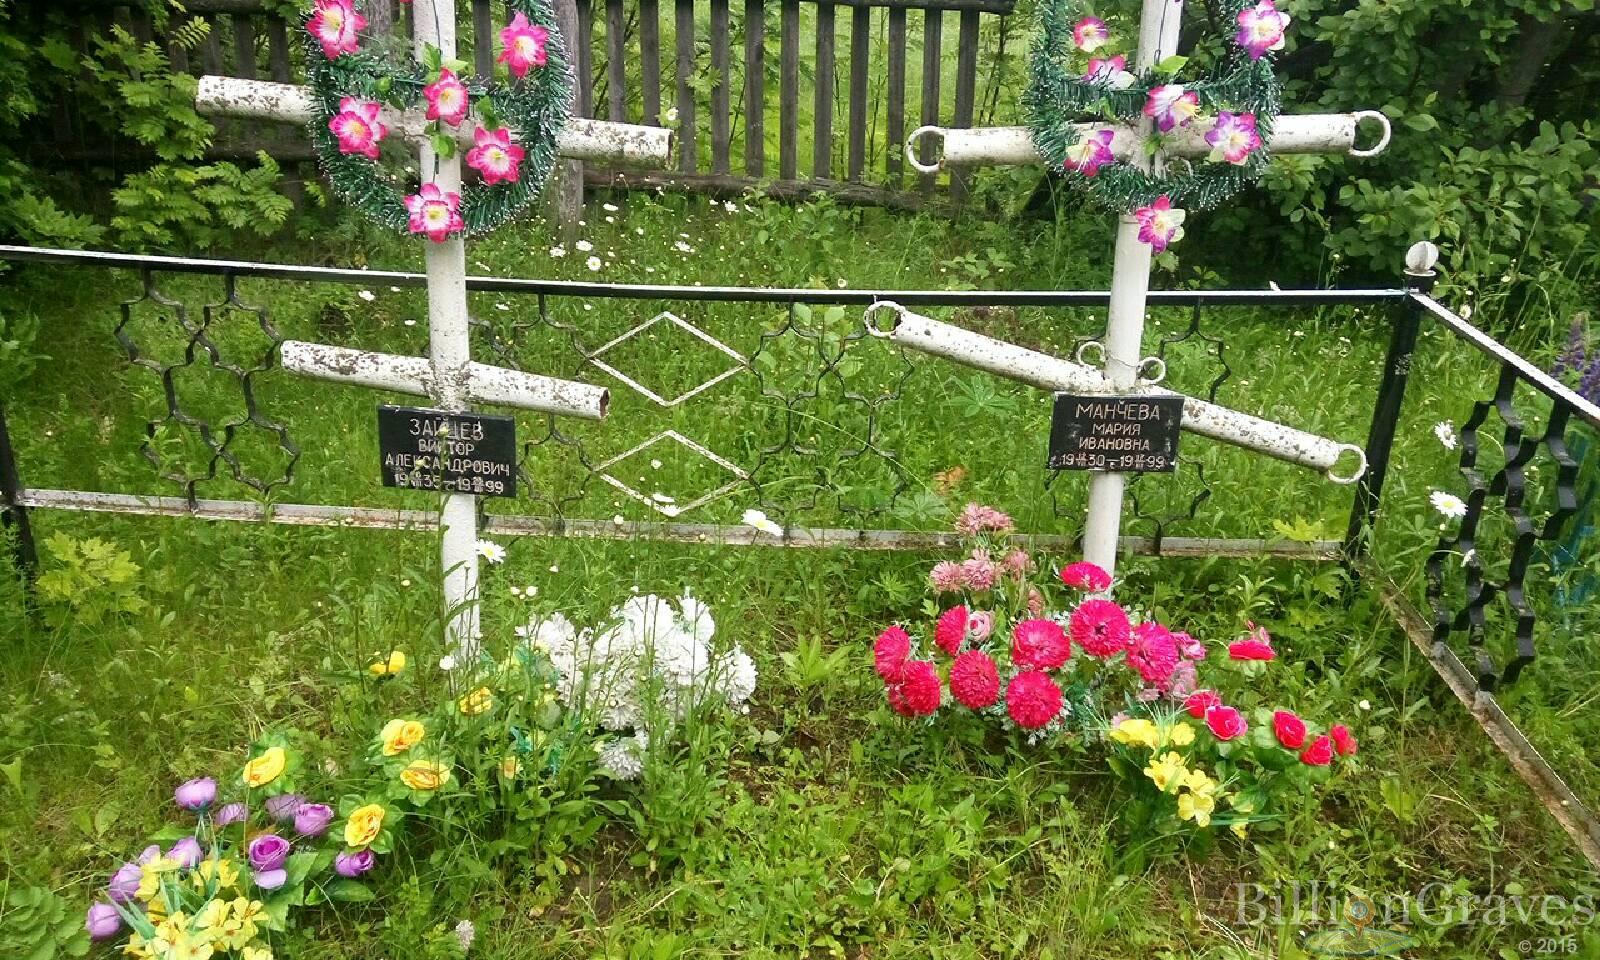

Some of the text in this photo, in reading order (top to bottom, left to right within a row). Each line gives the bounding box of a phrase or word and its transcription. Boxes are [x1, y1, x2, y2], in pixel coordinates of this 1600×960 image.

[1075, 403, 1160, 421] МАНЧЕВА
[1092, 423, 1141, 436] МАРИЯ
[1079, 437, 1151, 451] ИВАНОВНА
